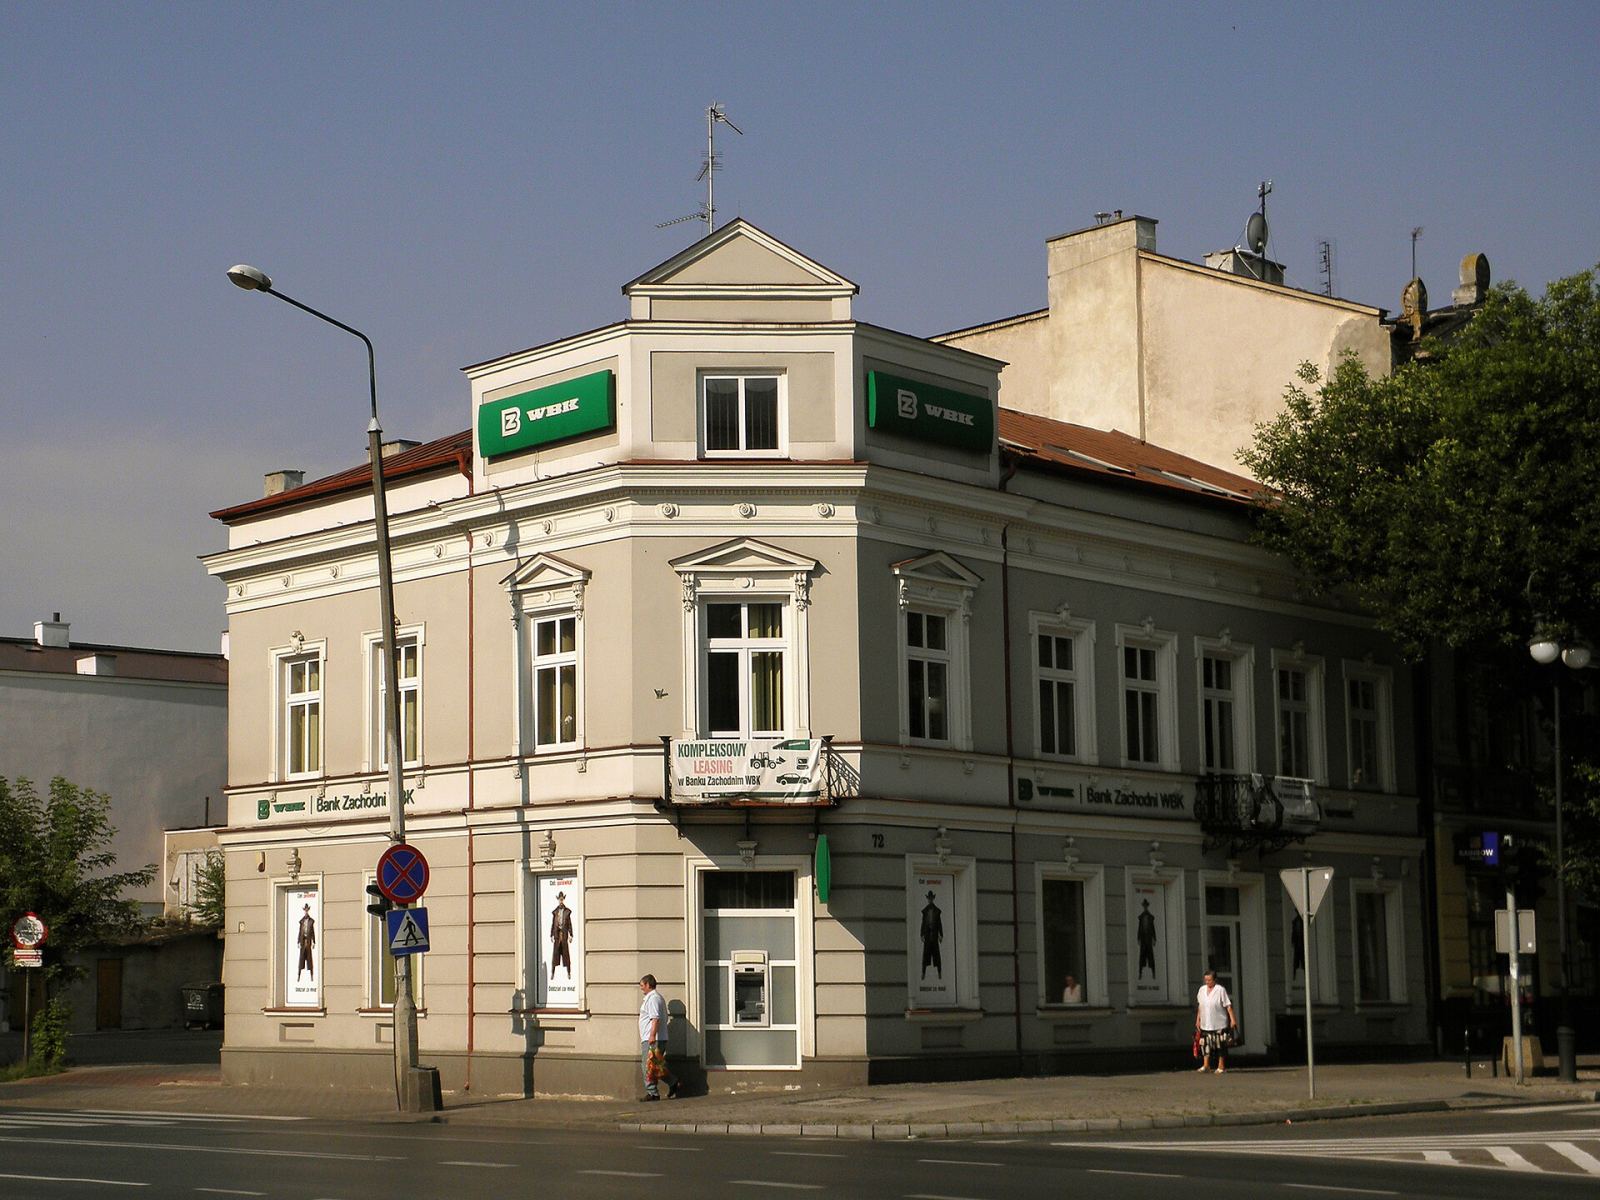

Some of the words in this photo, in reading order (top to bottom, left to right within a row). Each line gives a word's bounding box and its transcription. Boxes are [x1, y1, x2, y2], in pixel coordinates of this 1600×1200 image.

[526, 398, 579, 421] WBK
[924, 403, 974, 426] WBK
[677, 743, 747, 758] KOMPLEKSOWY
[693, 760, 733, 774] LEASING
[686, 776, 706, 786] Banku
[707, 775, 744, 786] Zachodnim
[745, 774, 761, 785] WBK
[316, 797, 340, 812] Bank
[342, 792, 387, 811] Zachodni
[1086, 787, 1113, 804] Bank
[1114, 789, 1159, 808] Zachodni
[1159, 792, 1185, 810] WBK
[871, 834, 885, 849] 72
